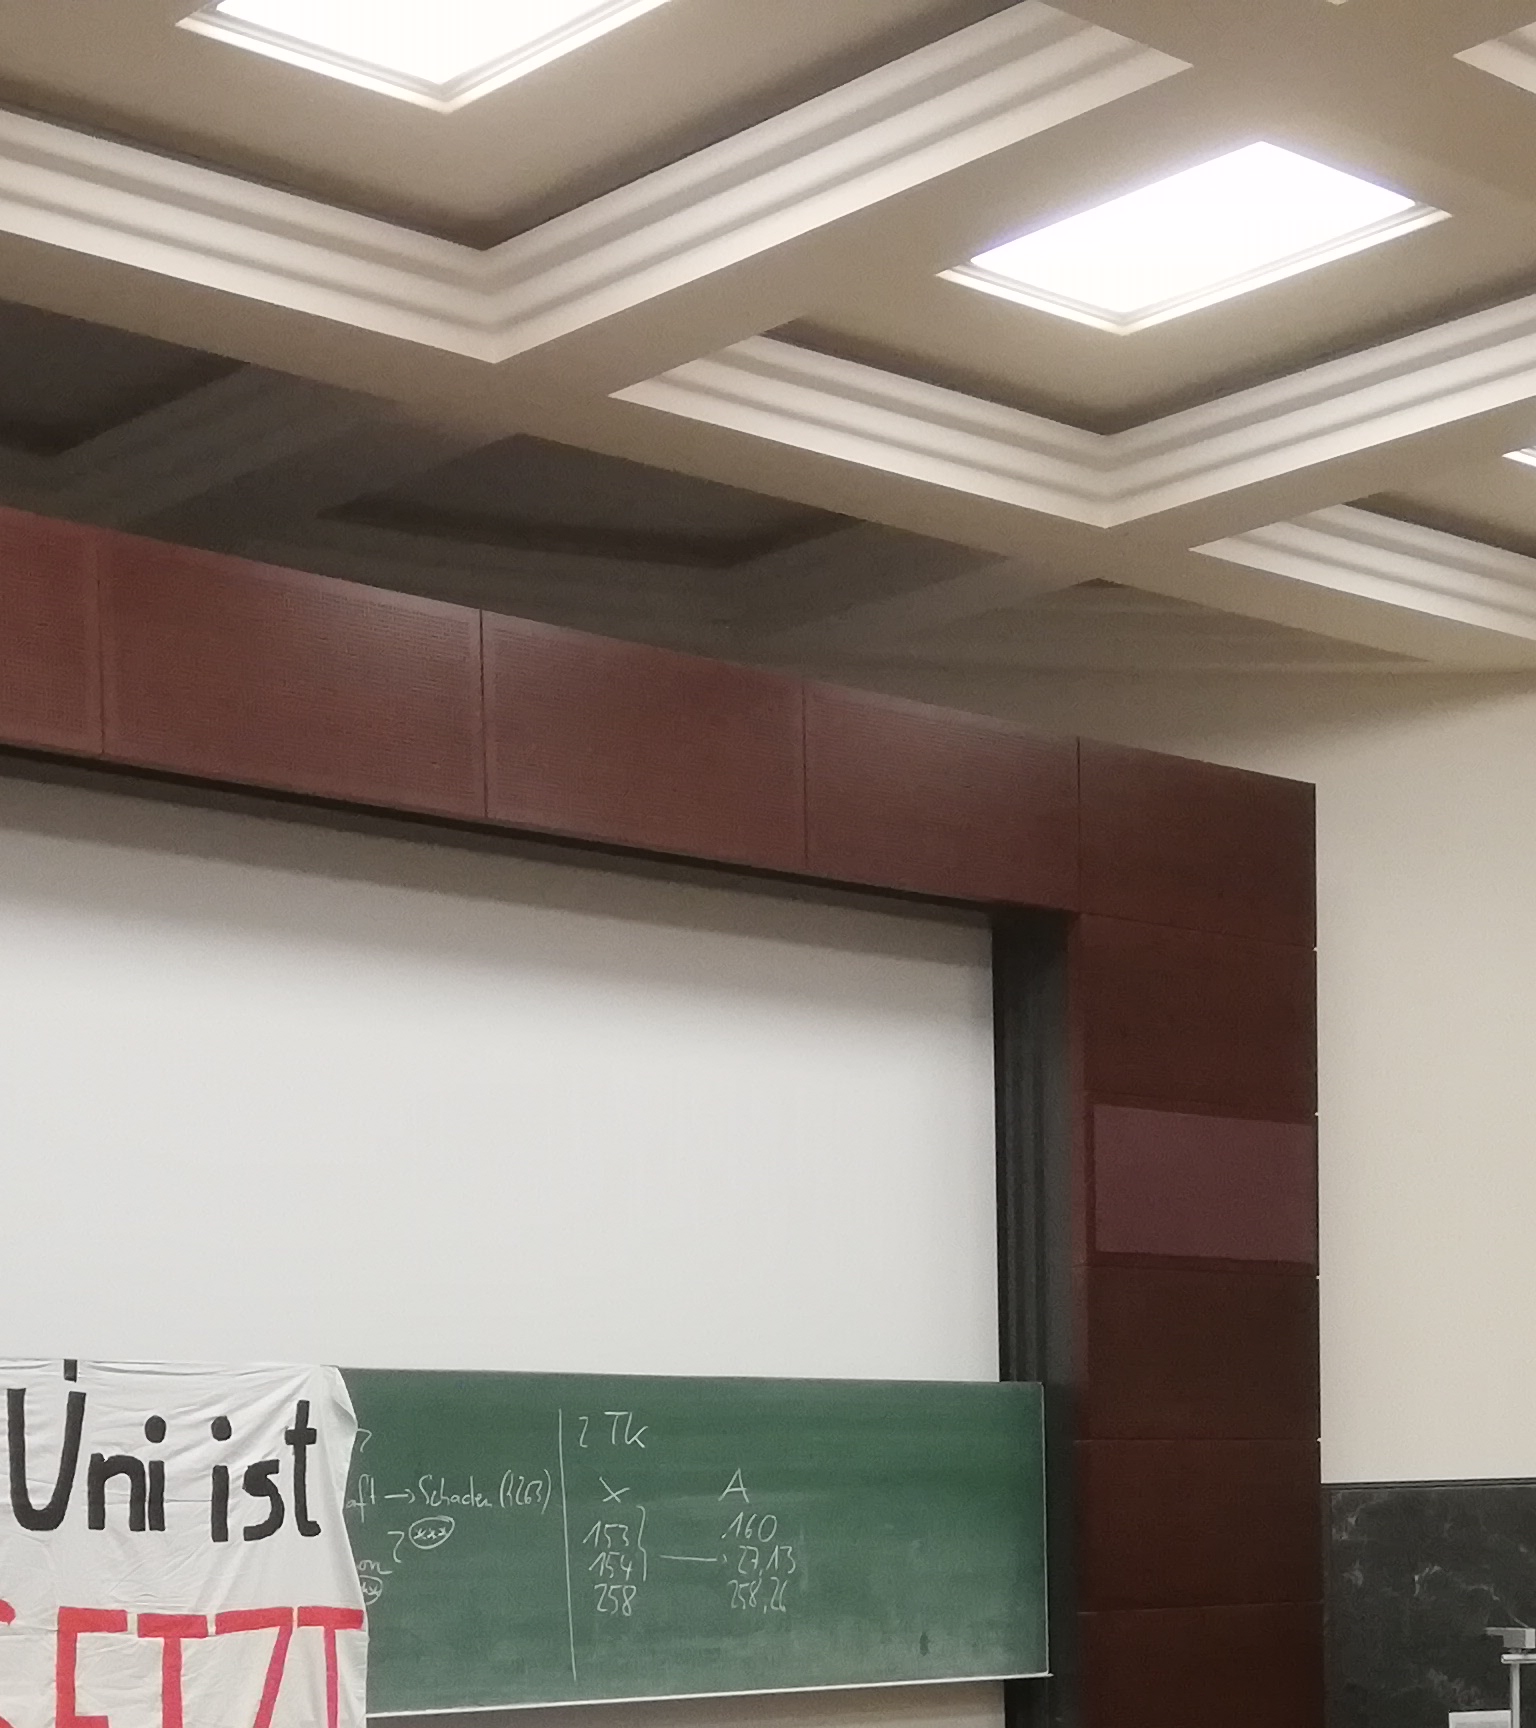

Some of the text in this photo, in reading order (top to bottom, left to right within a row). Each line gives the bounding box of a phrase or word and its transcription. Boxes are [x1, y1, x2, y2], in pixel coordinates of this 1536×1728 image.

[7, 1388, 167, 1533] Uni
[211, 1400, 322, 1542] ist
[718, 1467, 750, 1503] A
[582, 1521, 630, 1548] 153
[721, 1511, 778, 1543] 160
[588, 1551, 633, 1581] 154
[594, 1583, 637, 1617] 258
